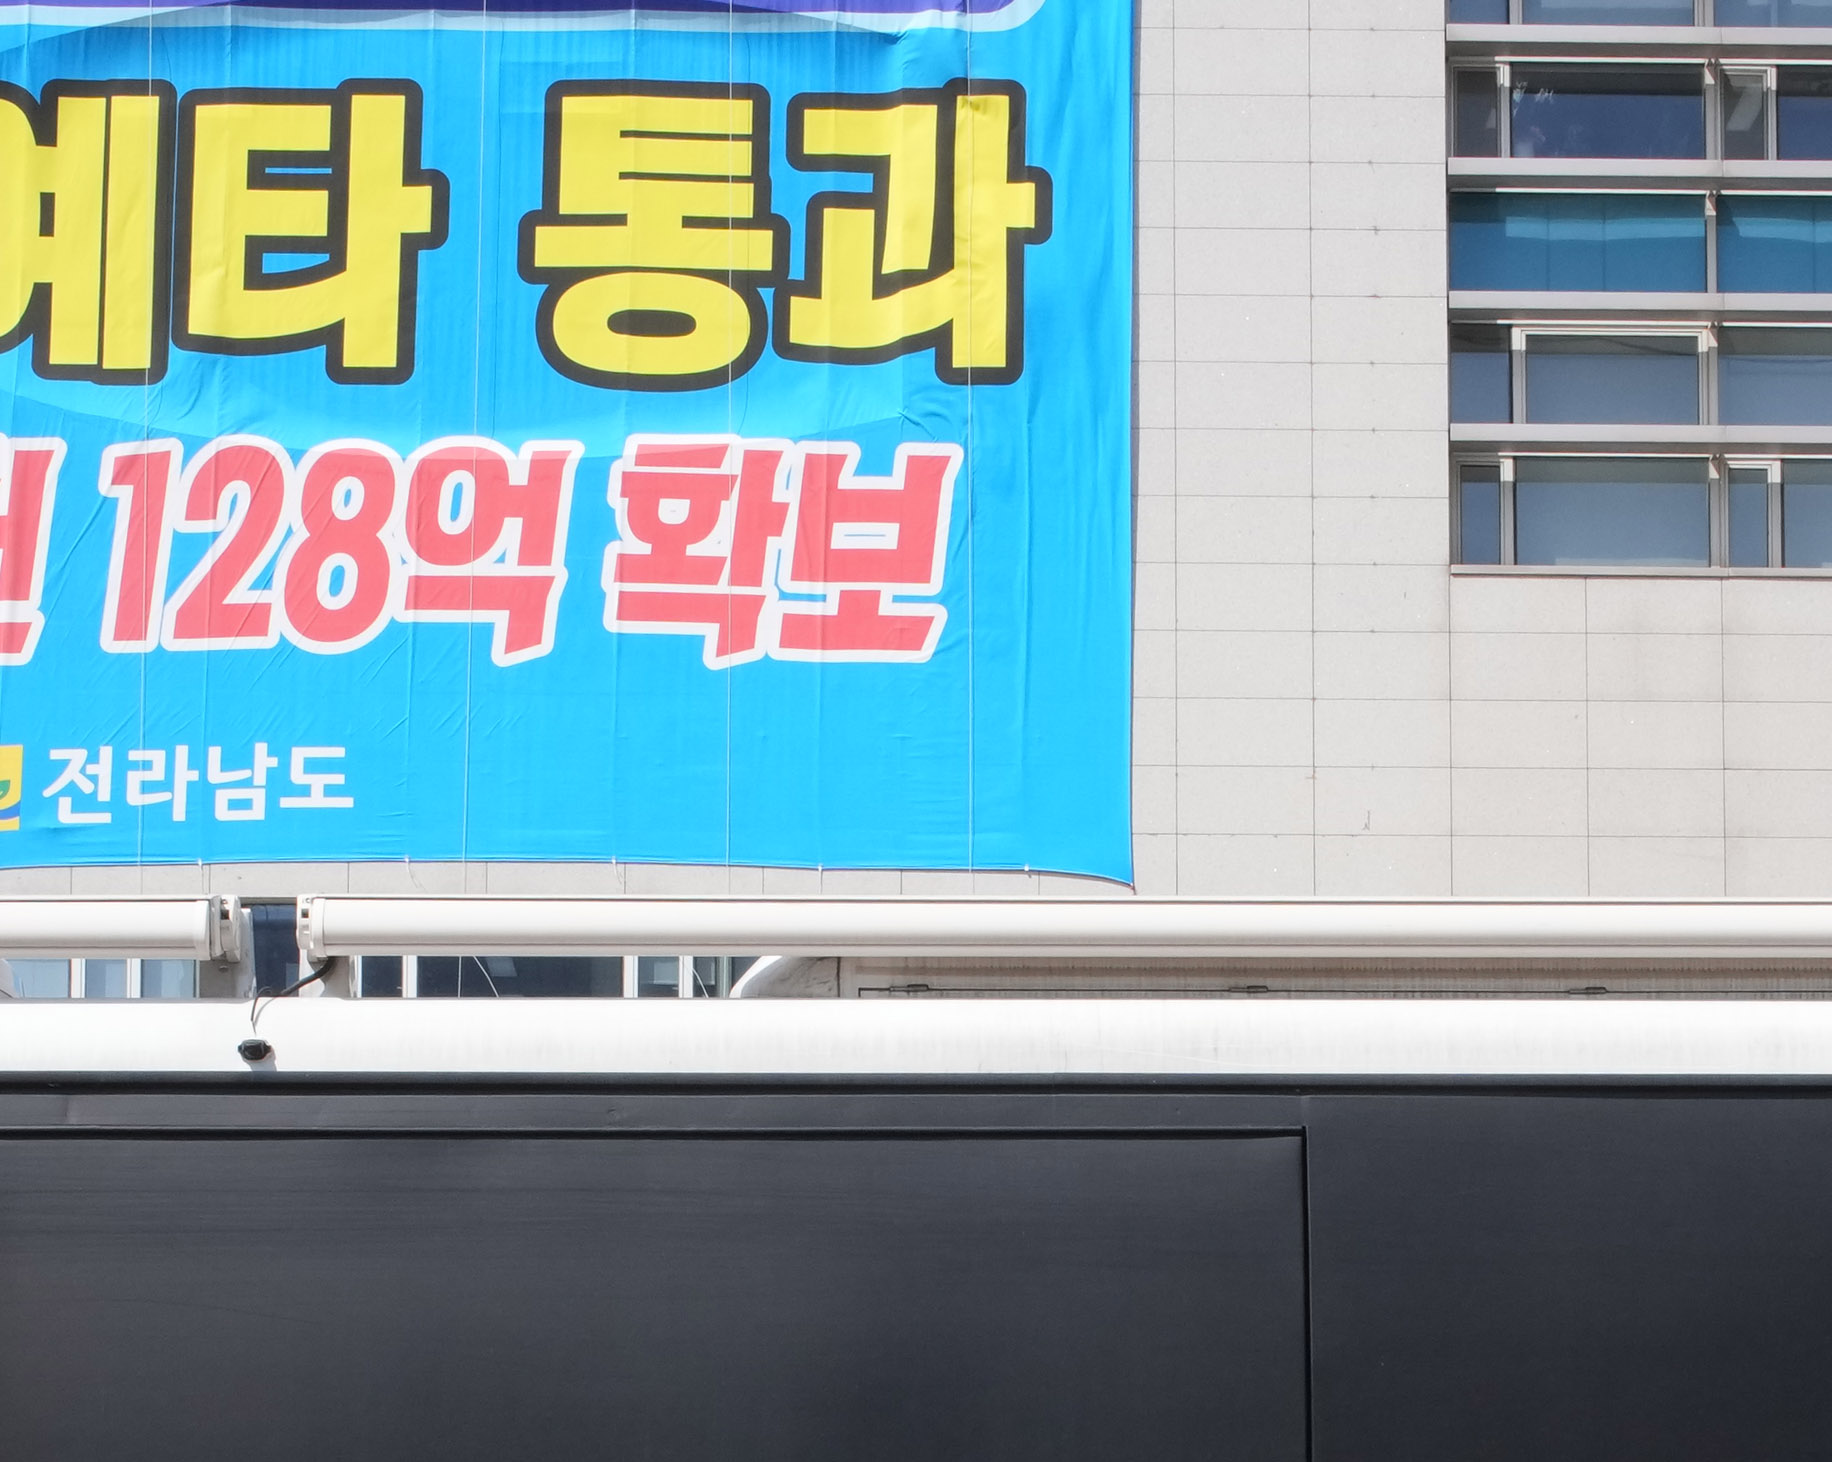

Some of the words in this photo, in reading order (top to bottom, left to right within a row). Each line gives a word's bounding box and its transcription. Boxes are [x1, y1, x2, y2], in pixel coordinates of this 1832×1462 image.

[520, 77, 1052, 385] 통과
[96, 436, 574, 667] 128억
[602, 431, 962, 667] 확보
[42, 742, 354, 824] 전라남도
